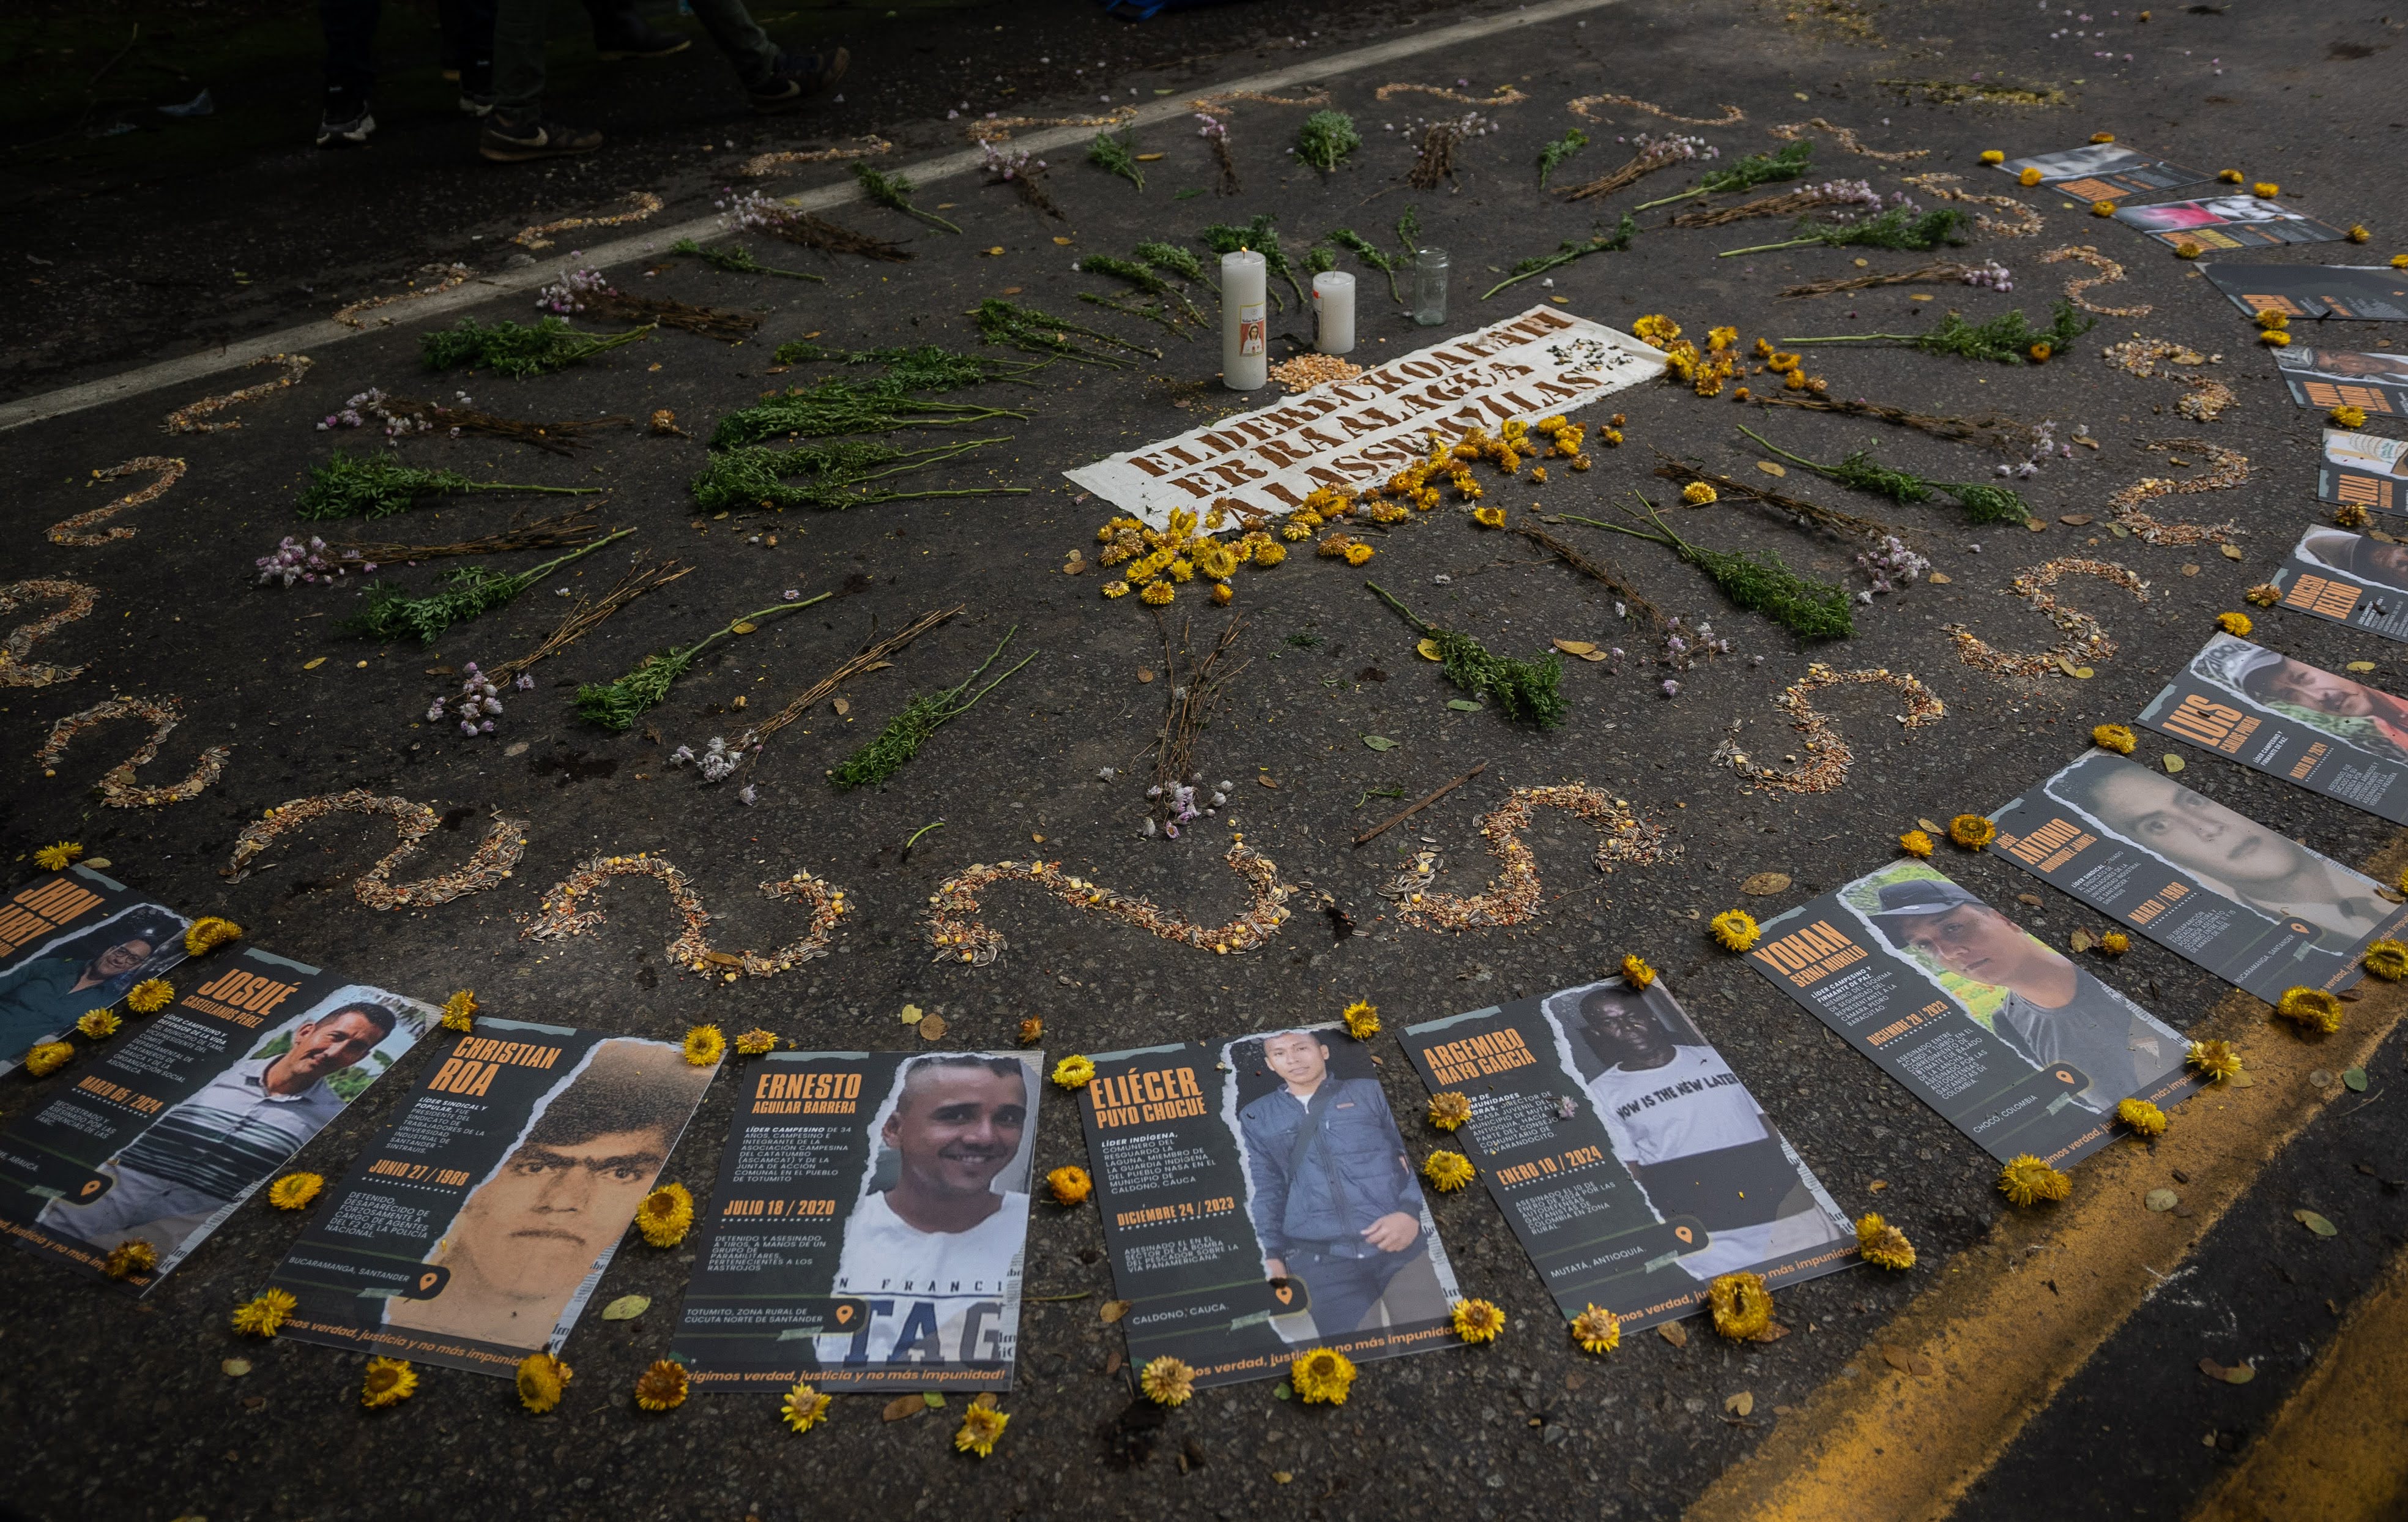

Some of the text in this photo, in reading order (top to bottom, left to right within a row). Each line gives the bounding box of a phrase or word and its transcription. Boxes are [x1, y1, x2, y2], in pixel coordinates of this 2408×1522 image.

[2161, 694, 2243, 747] LUIS
[2219, 715, 2262, 753] CARLOS PINEDA
[1994, 830, 2020, 849] JOSÉ
[2009, 818, 2081, 865] ANTONIO
[2070, 833, 2097, 852] JAIMES
[2071, 878, 2086, 888] LÍDER
[13, 878, 105, 925] JHON
[2128, 899, 2166, 925] MARZO
[2159, 881, 2190, 901] 1988
[1752, 920, 1853, 975] YOHAN
[2234, 934, 2295, 983] BUCARAMANGA, SANTANDER
[1789, 945, 1868, 988] SERNA MURILLO
[197, 968, 302, 1016] JOSUÉ
[1811, 987, 1830, 999] LÍDER
[1829, 969, 1867, 989] CAMPESINO
[1817, 984, 1849, 1003] FIRMANTE
[163, 1013, 184, 1023] LÍDER
[182, 1020, 221, 1035] CAMPESINO
[181, 995, 264, 1029] CASTELLANOS PÉREZ
[1867, 1019, 1912, 1046] DICIEMBRE
[1906, 1013, 1923, 1026] 28
[1922, 1000, 1949, 1017] 2023
[157, 1018, 191, 1032] DEFENSOR
[209, 1036, 227, 1045] VIDA
[452, 1036, 562, 1069] CHRISTIAN
[1423, 1028, 1525, 1070] ARGEMIRO
[428, 1058, 500, 1097] ROA
[755, 1073, 862, 1099] ERNESTO
[1433, 1061, 1480, 1086] MAYO
[78, 1076, 117, 1096] MARZO
[110, 1087, 131, 1102] 05
[130, 1095, 163, 1114] 2024
[1087, 1067, 1201, 1110] ELIÉCER
[1641, 1095, 1657, 1108] IS
[1654, 1087, 1679, 1102] THE
[1675, 1079, 1705, 1096] NEW
[411, 1108, 455, 1119] PRESIDENTE
[415, 1103, 452, 1113] POPULAR,
[442, 1100, 479, 1110] SINDICAL
[752, 1101, 856, 1114] AGUILAR BARRERA
[1096, 1106, 1140, 1129] PUYO
[2001, 1095, 2038, 1117] COLOMBIA
[1101, 1132, 1178, 1147] LÍDER INDÍGENA,
[1102, 1141, 1156, 1154] COMUNERO
[368, 1159, 411, 1177] JUNIO
[407, 1165, 429, 1179] 27
[435, 1169, 470, 1186] 1988
[1496, 1162, 1540, 1185] ENERO
[1538, 1157, 1558, 1174] 10
[1564, 1145, 1603, 1166] 2024
[344, 1198, 415, 1215] DESAPARECIDO
[348, 1192, 395, 1205] DETENIDO,
[723, 1200, 764, 1215] JULIO
[768, 1200, 784, 1215] 18
[797, 1199, 835, 1215] 2020
[1117, 1206, 1176, 1226] DICIEMBRE
[1178, 1203, 1194, 1217] 24
[1204, 1196, 1235, 1212] 2023
[288, 1256, 410, 1282] BUCARAMANGA, SANTANDER
[311, 1323, 359, 1338] verdad,
[355, 1329, 408, 1346] justicia
[418, 1342, 436, 1351] no
[436, 1345, 466, 1356] más
[681, 1370, 741, 1383] xigimos
[744, 1371, 797, 1382] verdad,
[797, 1370, 852, 1384] justicia
[887, 1371, 918, 1380] más
[921, 1370, 1006, 1382] impunidad!
